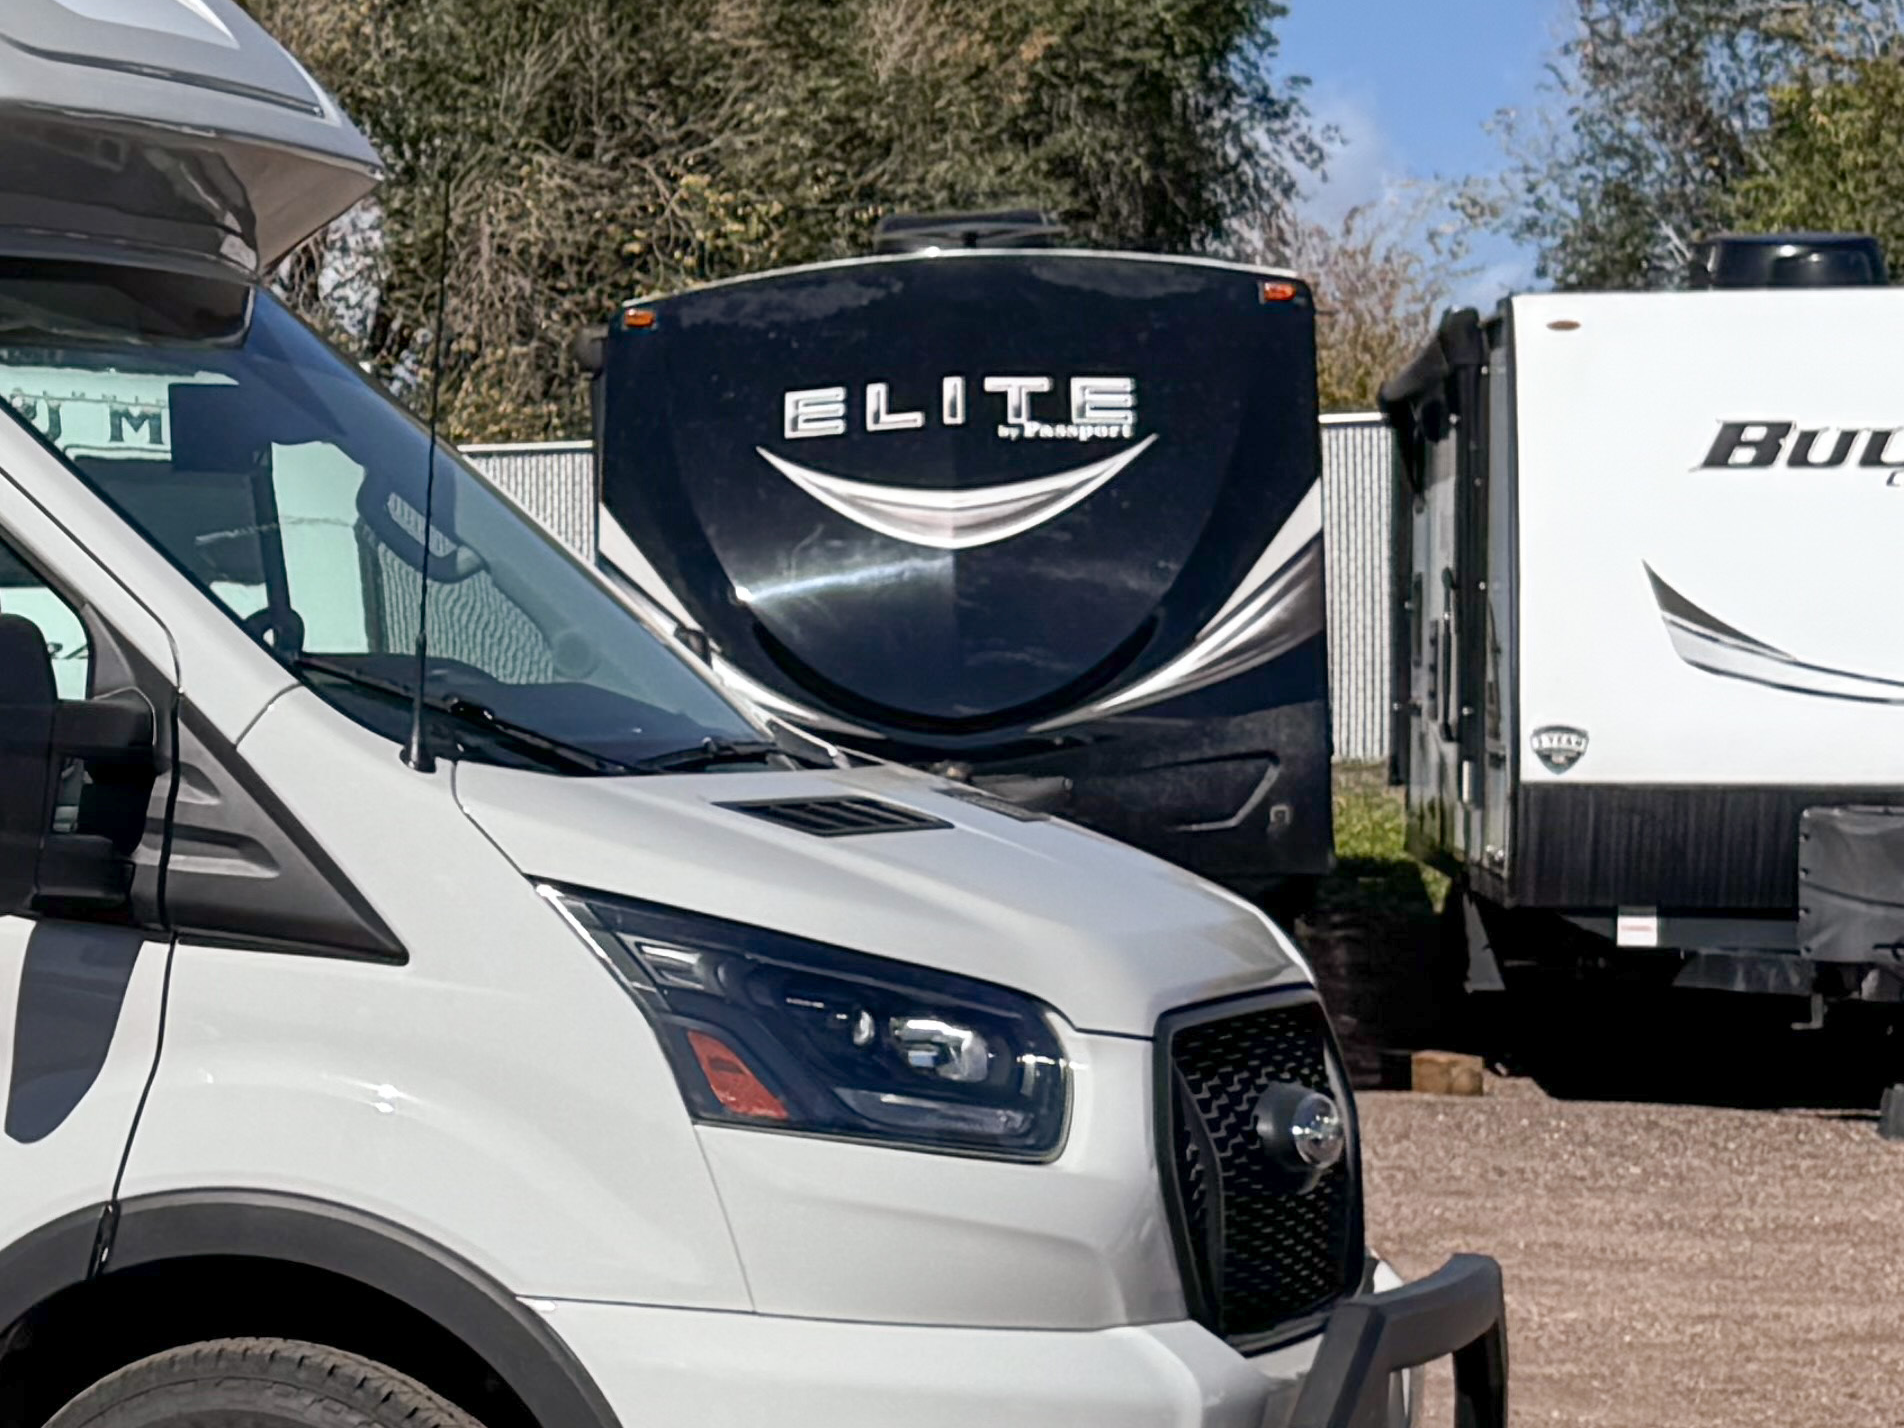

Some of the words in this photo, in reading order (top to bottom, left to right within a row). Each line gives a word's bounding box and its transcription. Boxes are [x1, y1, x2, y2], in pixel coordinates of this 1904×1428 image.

[783, 376, 1136, 440] ELITE
[997, 424, 1020, 441] by
[1023, 421, 1134, 442] Passport
